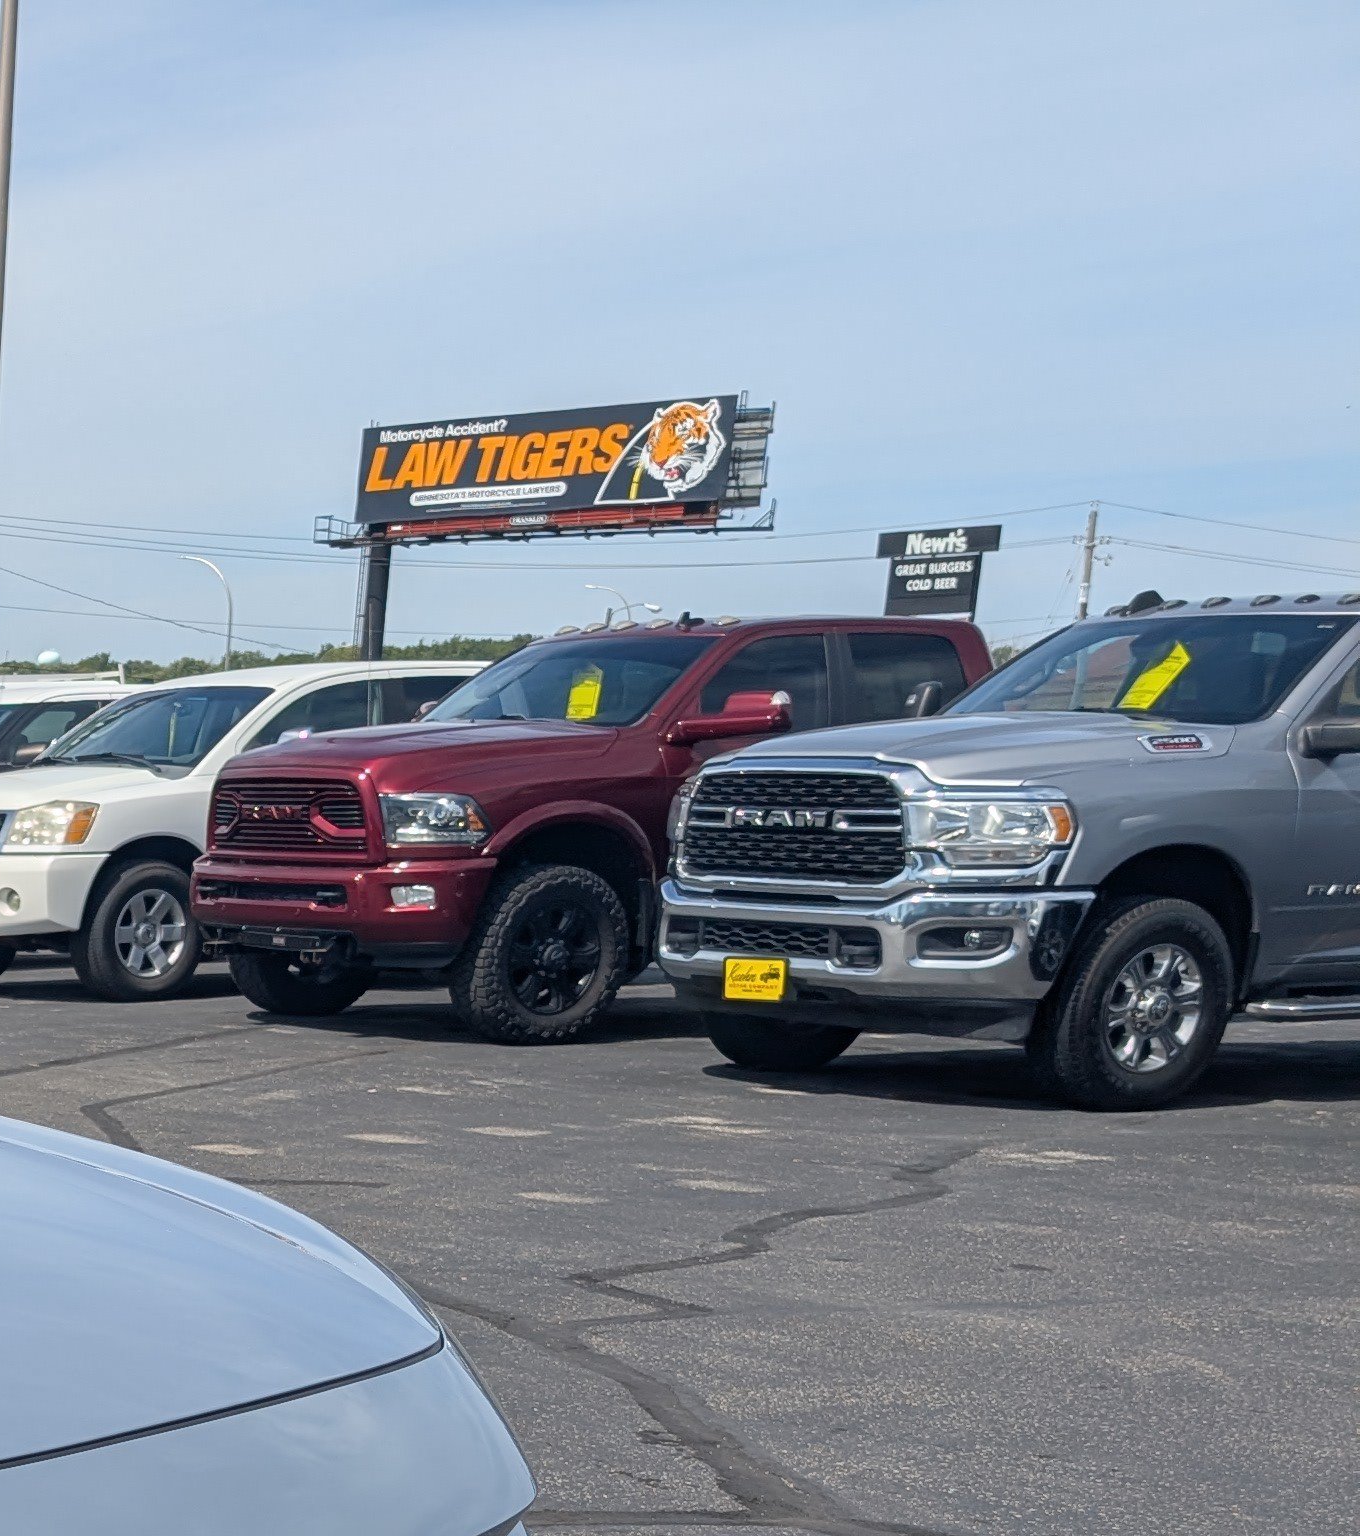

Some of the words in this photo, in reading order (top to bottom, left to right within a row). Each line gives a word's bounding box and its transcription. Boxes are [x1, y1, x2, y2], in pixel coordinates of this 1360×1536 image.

[380, 425, 445, 443] Motorcycle
[445, 418, 509, 438] Accident?
[364, 438, 473, 492] LAW
[475, 423, 629, 483] TIGERS
[467, 487, 522, 499] MOTORCYCLE
[522, 484, 561, 496] LAWYERS
[905, 529, 968, 555] Newt's
[895, 562, 927, 577] GREAT
[928, 560, 974, 575] BURGERS
[906, 578, 931, 591] COLD
[934, 577, 958, 590] BEER
[734, 809, 827, 827] RAM
